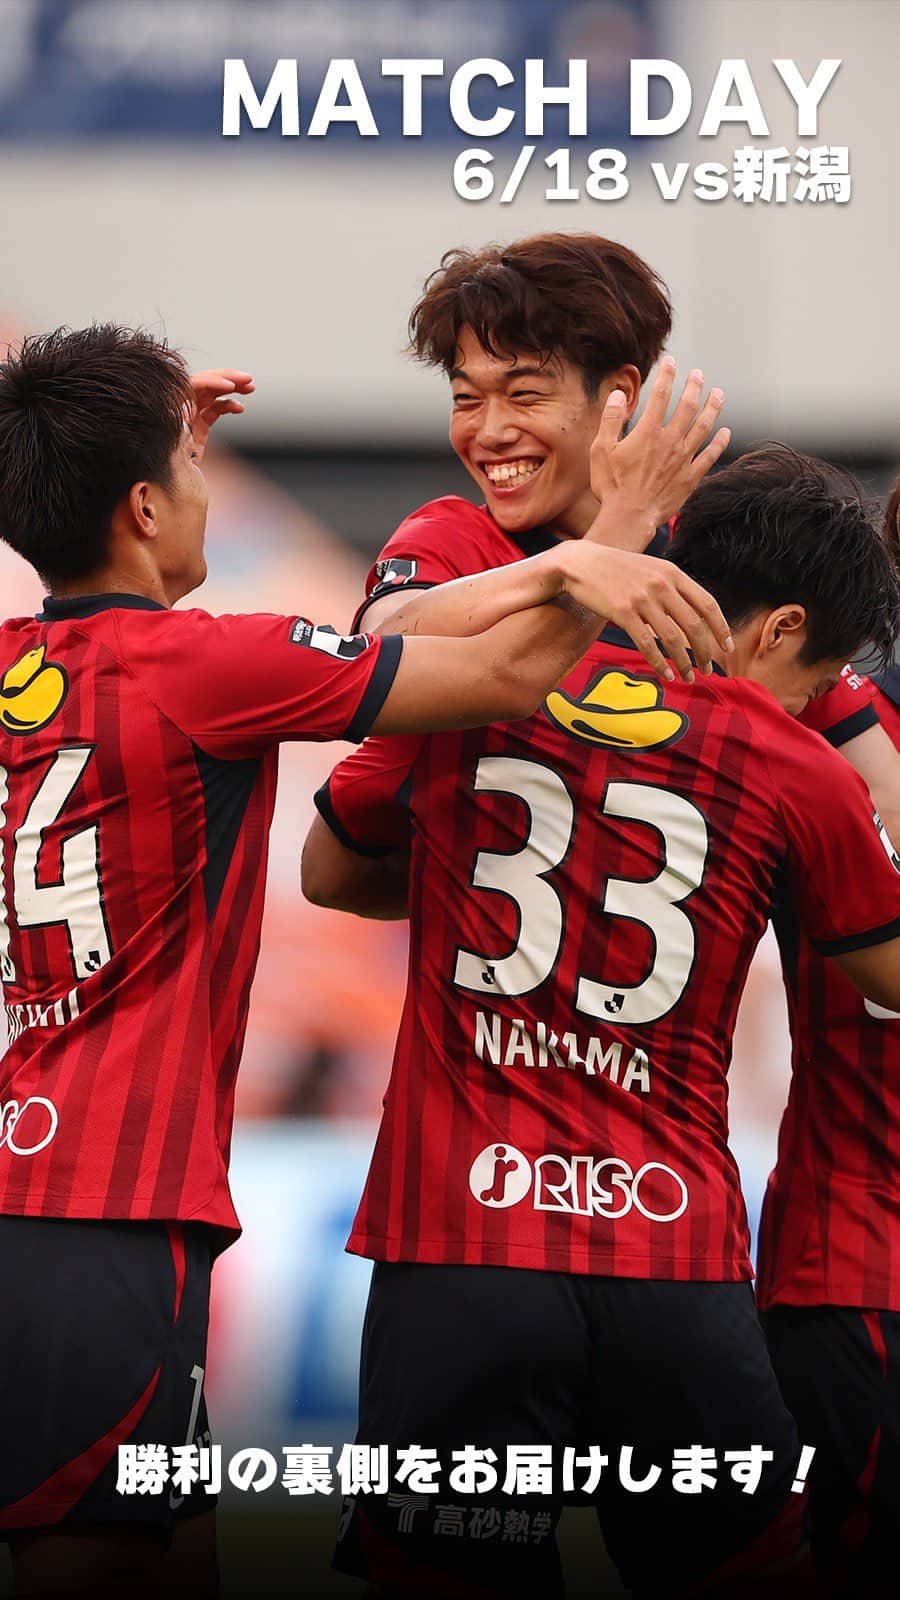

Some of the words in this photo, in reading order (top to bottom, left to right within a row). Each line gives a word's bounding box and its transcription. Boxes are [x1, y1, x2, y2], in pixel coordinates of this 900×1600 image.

[454, 757, 709, 1024] 33
[475, 1011, 651, 1093] NAKAMA
[534, 1154, 689, 1222] RISO
[433, 1504, 551, 1544] 高砂熱学
